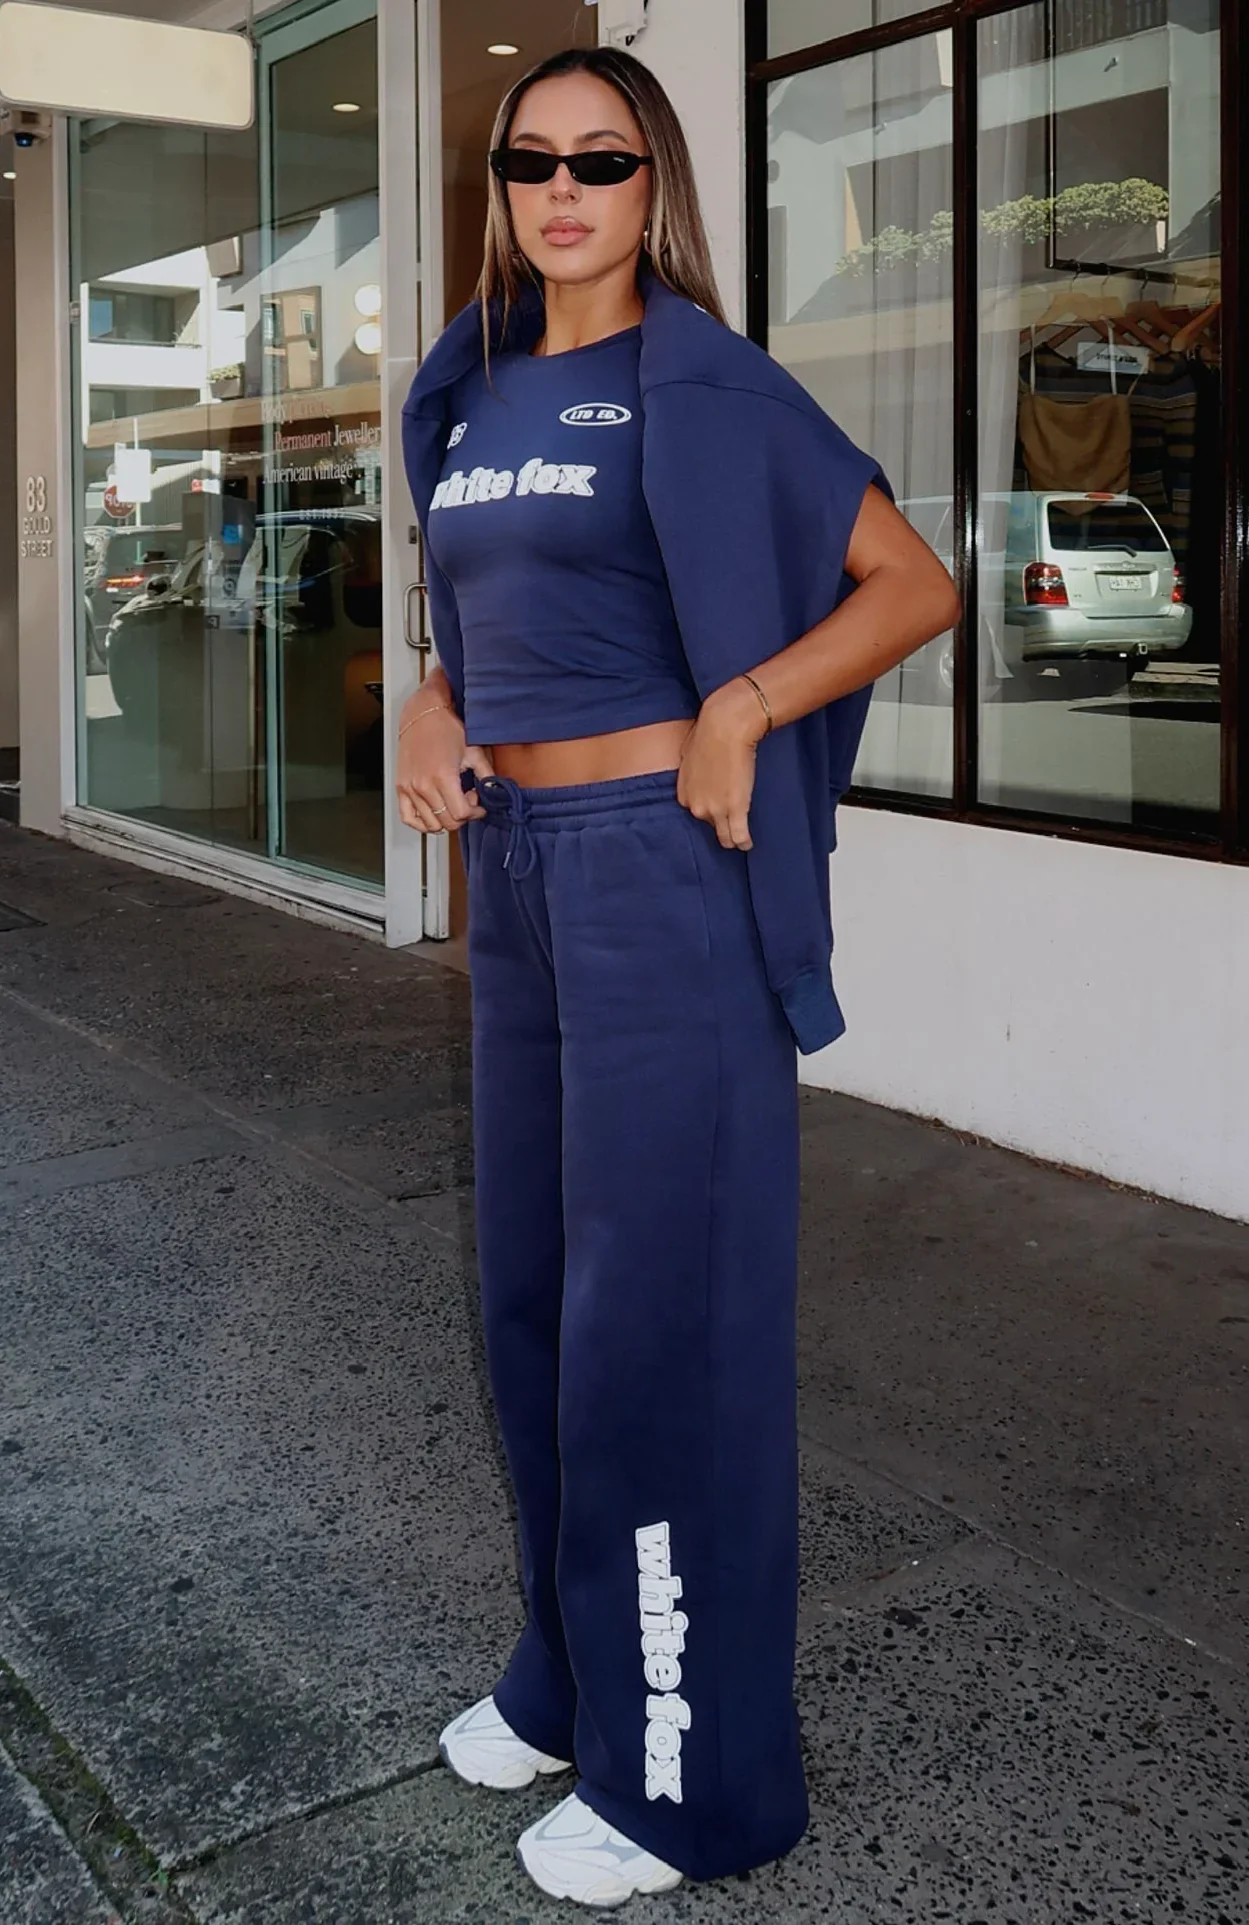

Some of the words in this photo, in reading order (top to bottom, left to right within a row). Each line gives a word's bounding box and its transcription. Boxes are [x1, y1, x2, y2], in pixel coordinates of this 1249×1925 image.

[569, 409, 594, 420] LTD
[274, 430, 332, 451] Permanent
[262, 462, 313, 484] American
[314, 458, 353, 484] vintage
[515, 457, 597, 497] fox
[26, 476, 46, 512] 83
[21, 539, 53, 557] STREET
[635, 1520, 689, 1691] white
[645, 1692, 691, 1804] fox
